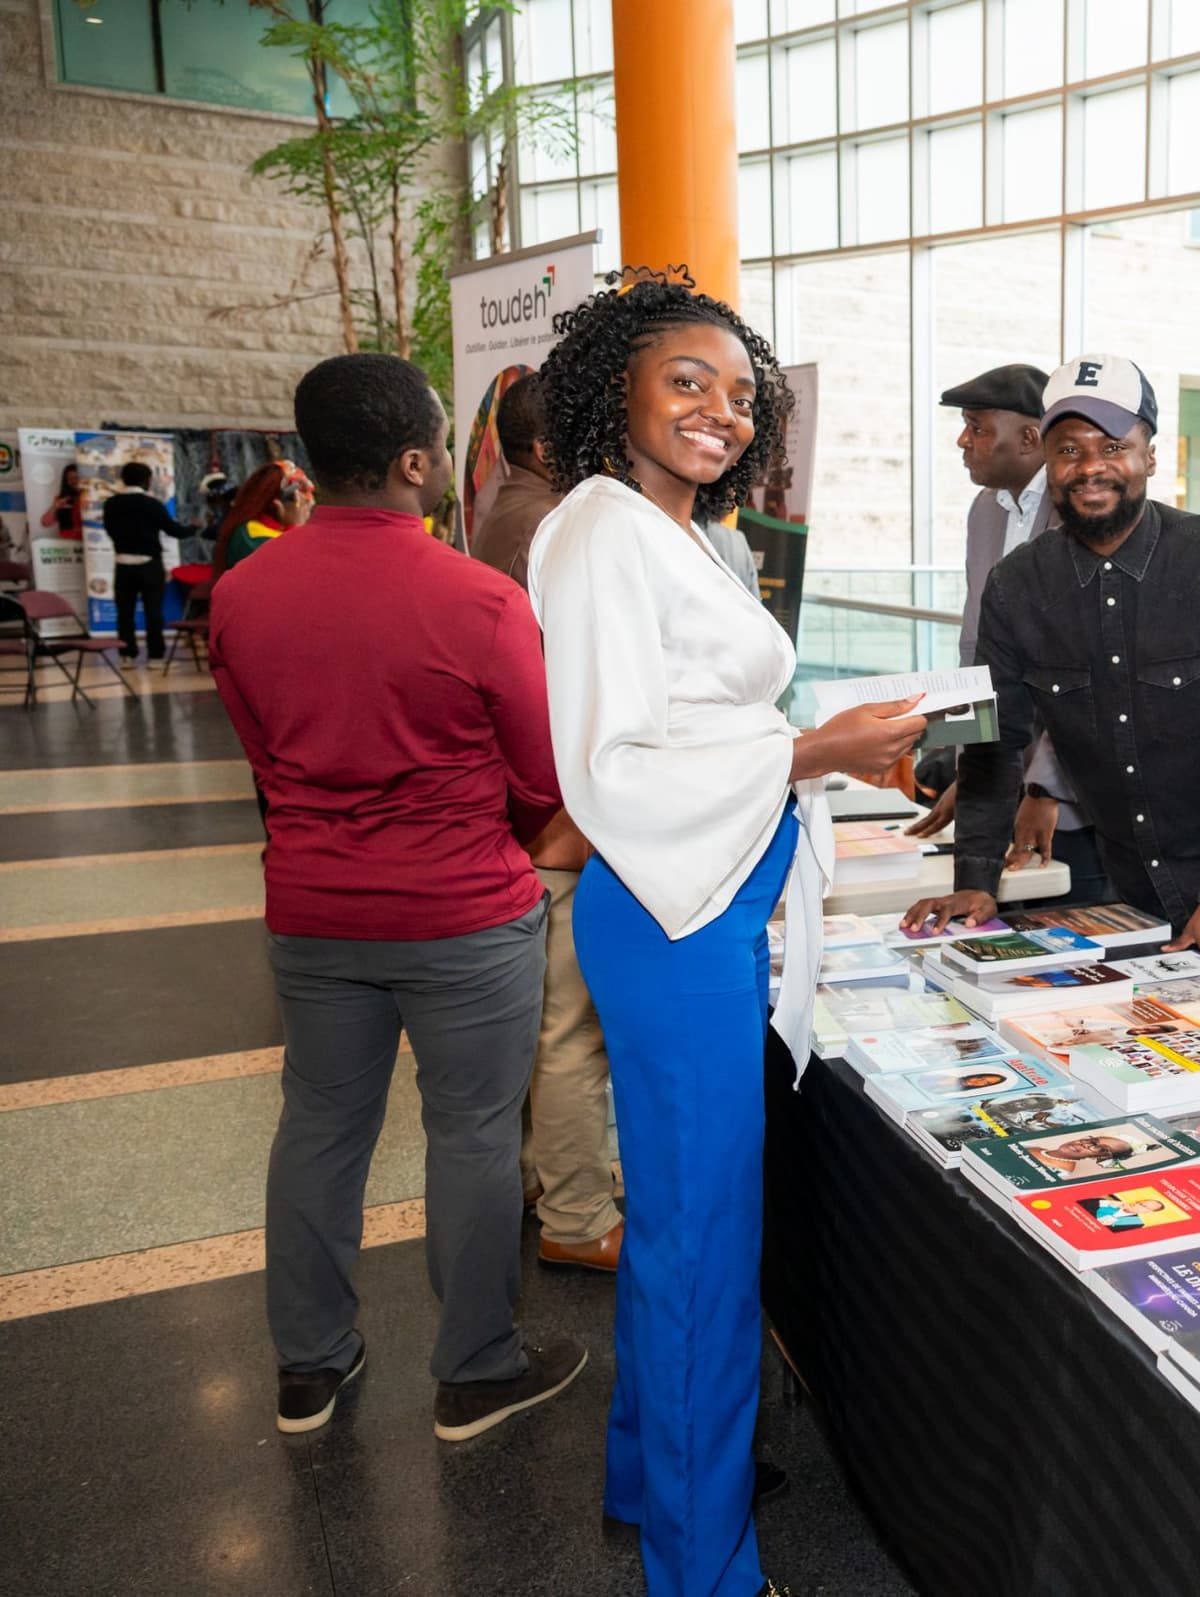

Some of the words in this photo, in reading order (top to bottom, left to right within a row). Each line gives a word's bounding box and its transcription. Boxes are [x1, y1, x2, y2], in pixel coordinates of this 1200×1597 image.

[480, 284, 546, 329] toudeh
[1075, 362, 1102, 386] E
[1171, 1264, 1193, 1277] LE
